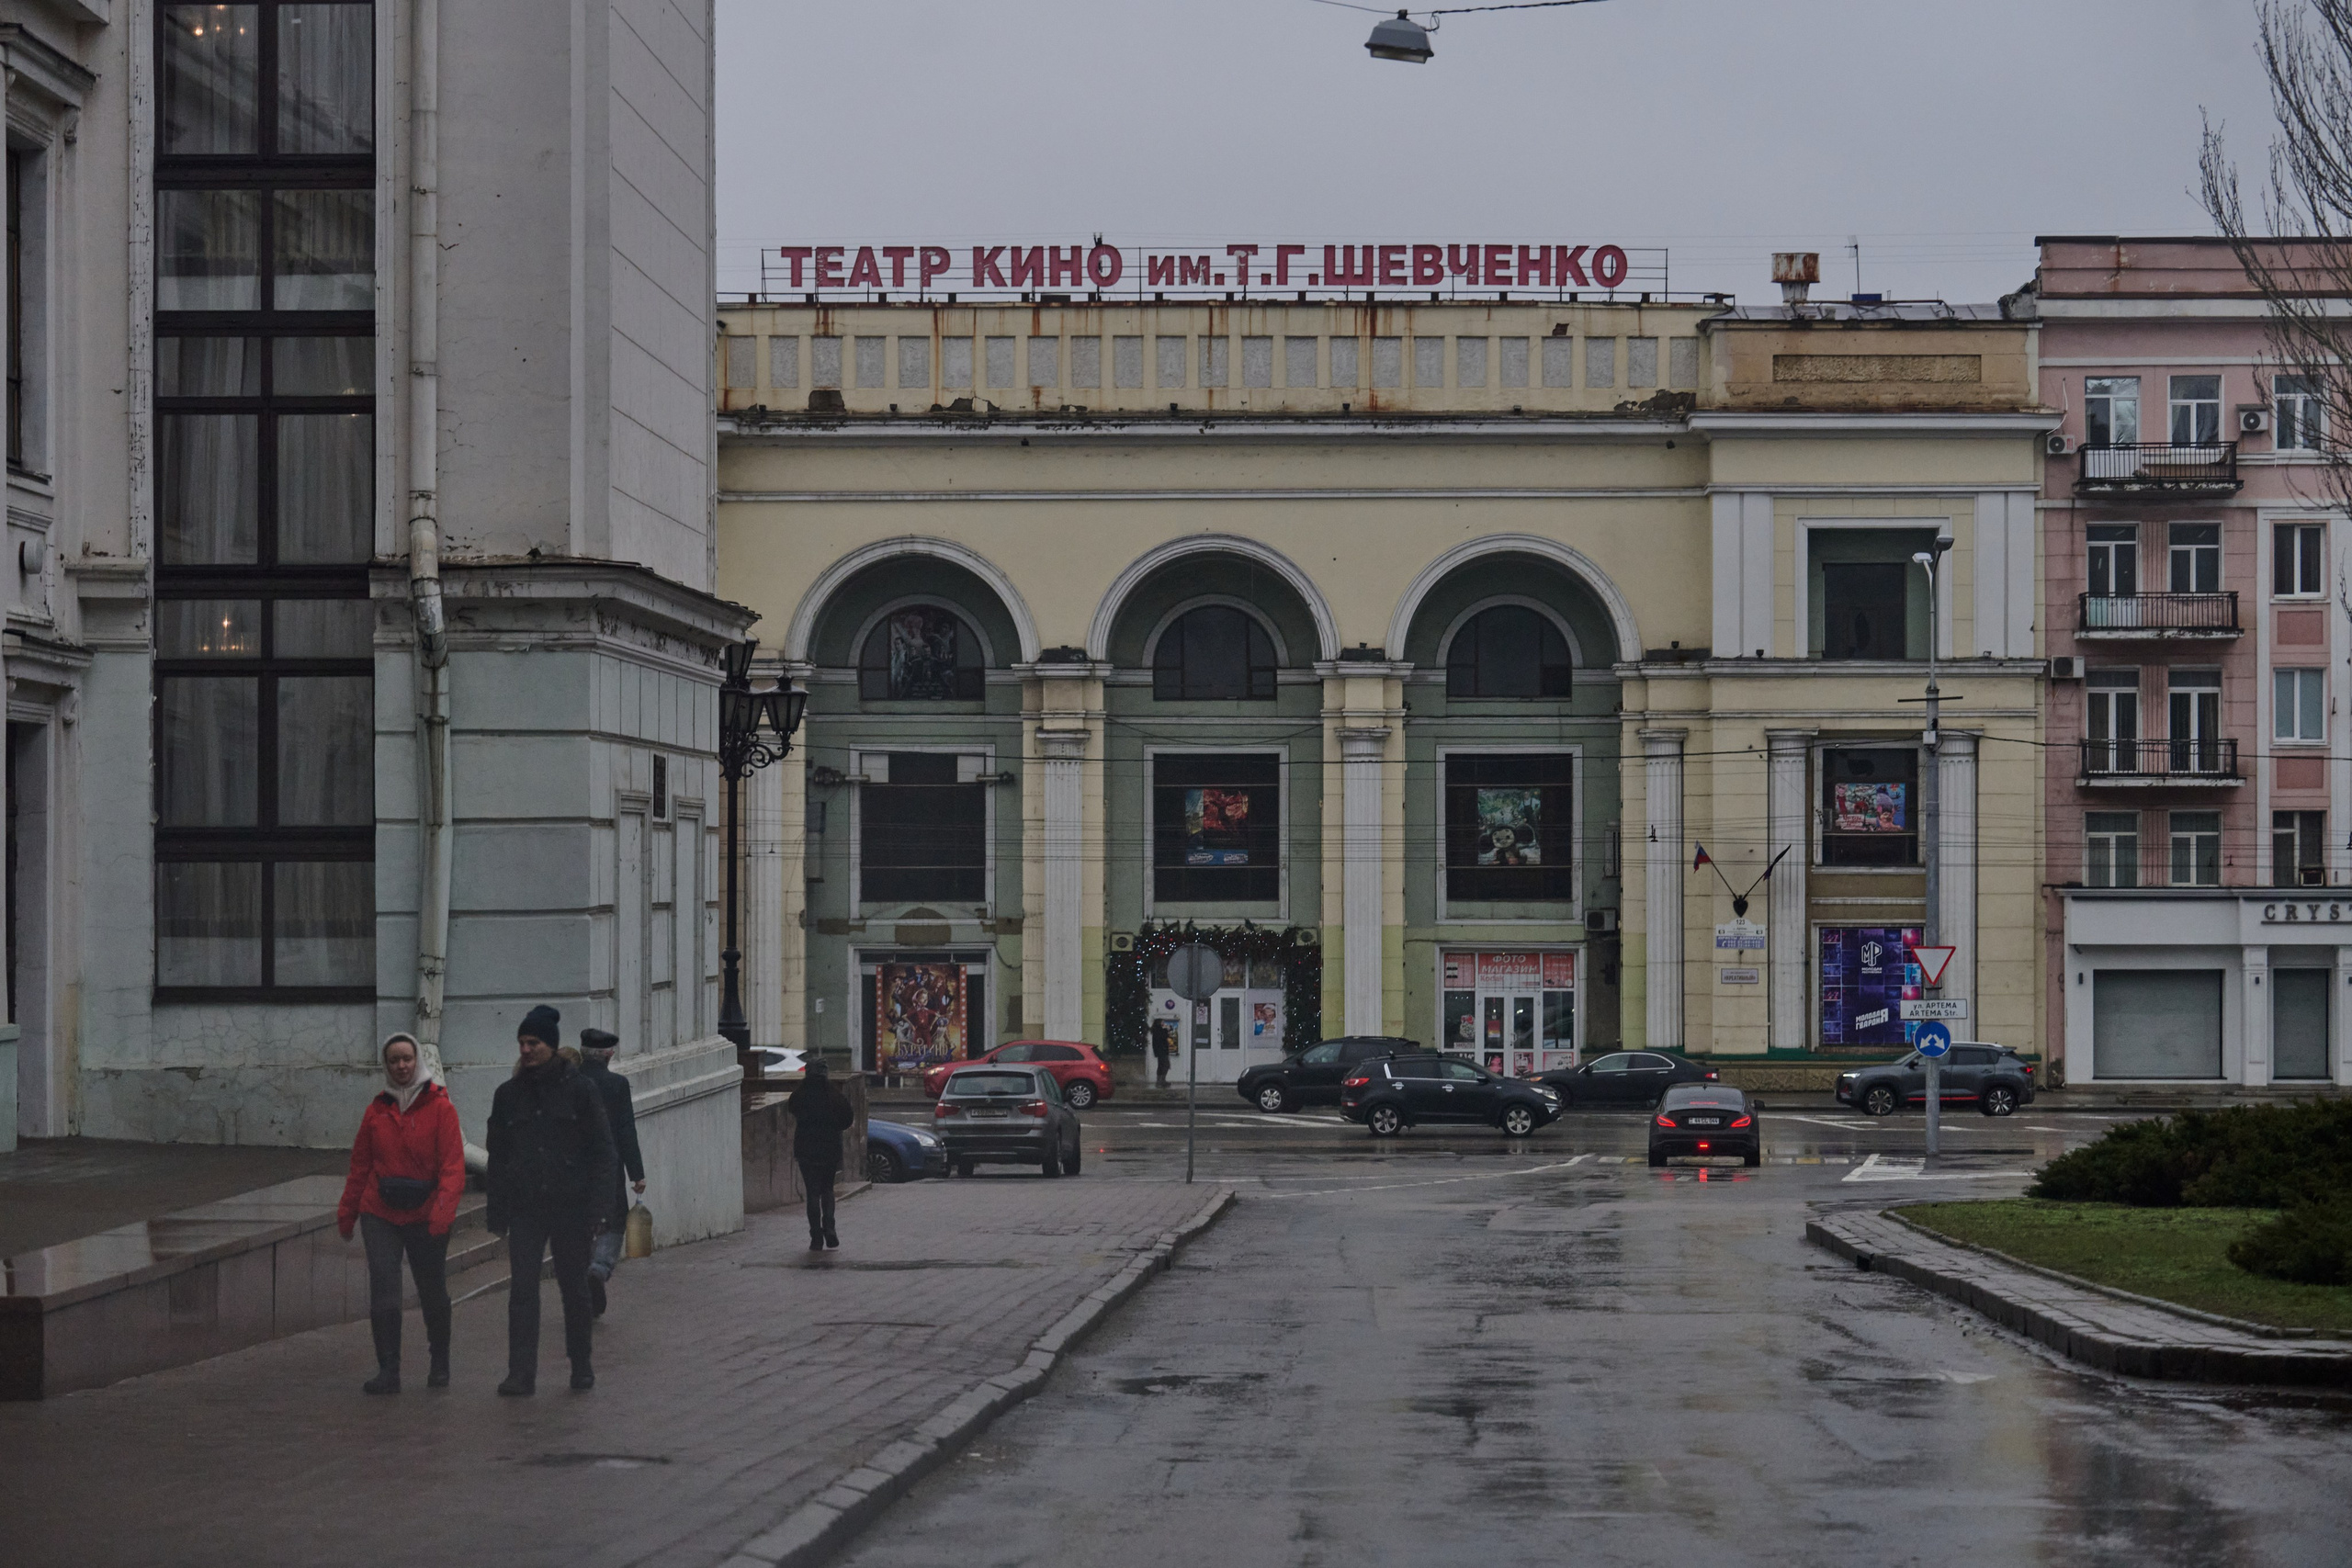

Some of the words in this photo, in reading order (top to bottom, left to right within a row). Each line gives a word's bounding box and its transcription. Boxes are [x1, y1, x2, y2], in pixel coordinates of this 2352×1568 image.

[781, 246, 951, 288] ТЕАТР
[972, 243, 1123, 288] КИНО
[2264, 903, 2352, 920] CRYS
[1492, 954, 1526, 964] ФОТО
[1481, 964, 1538, 974] МАГАЗИН
